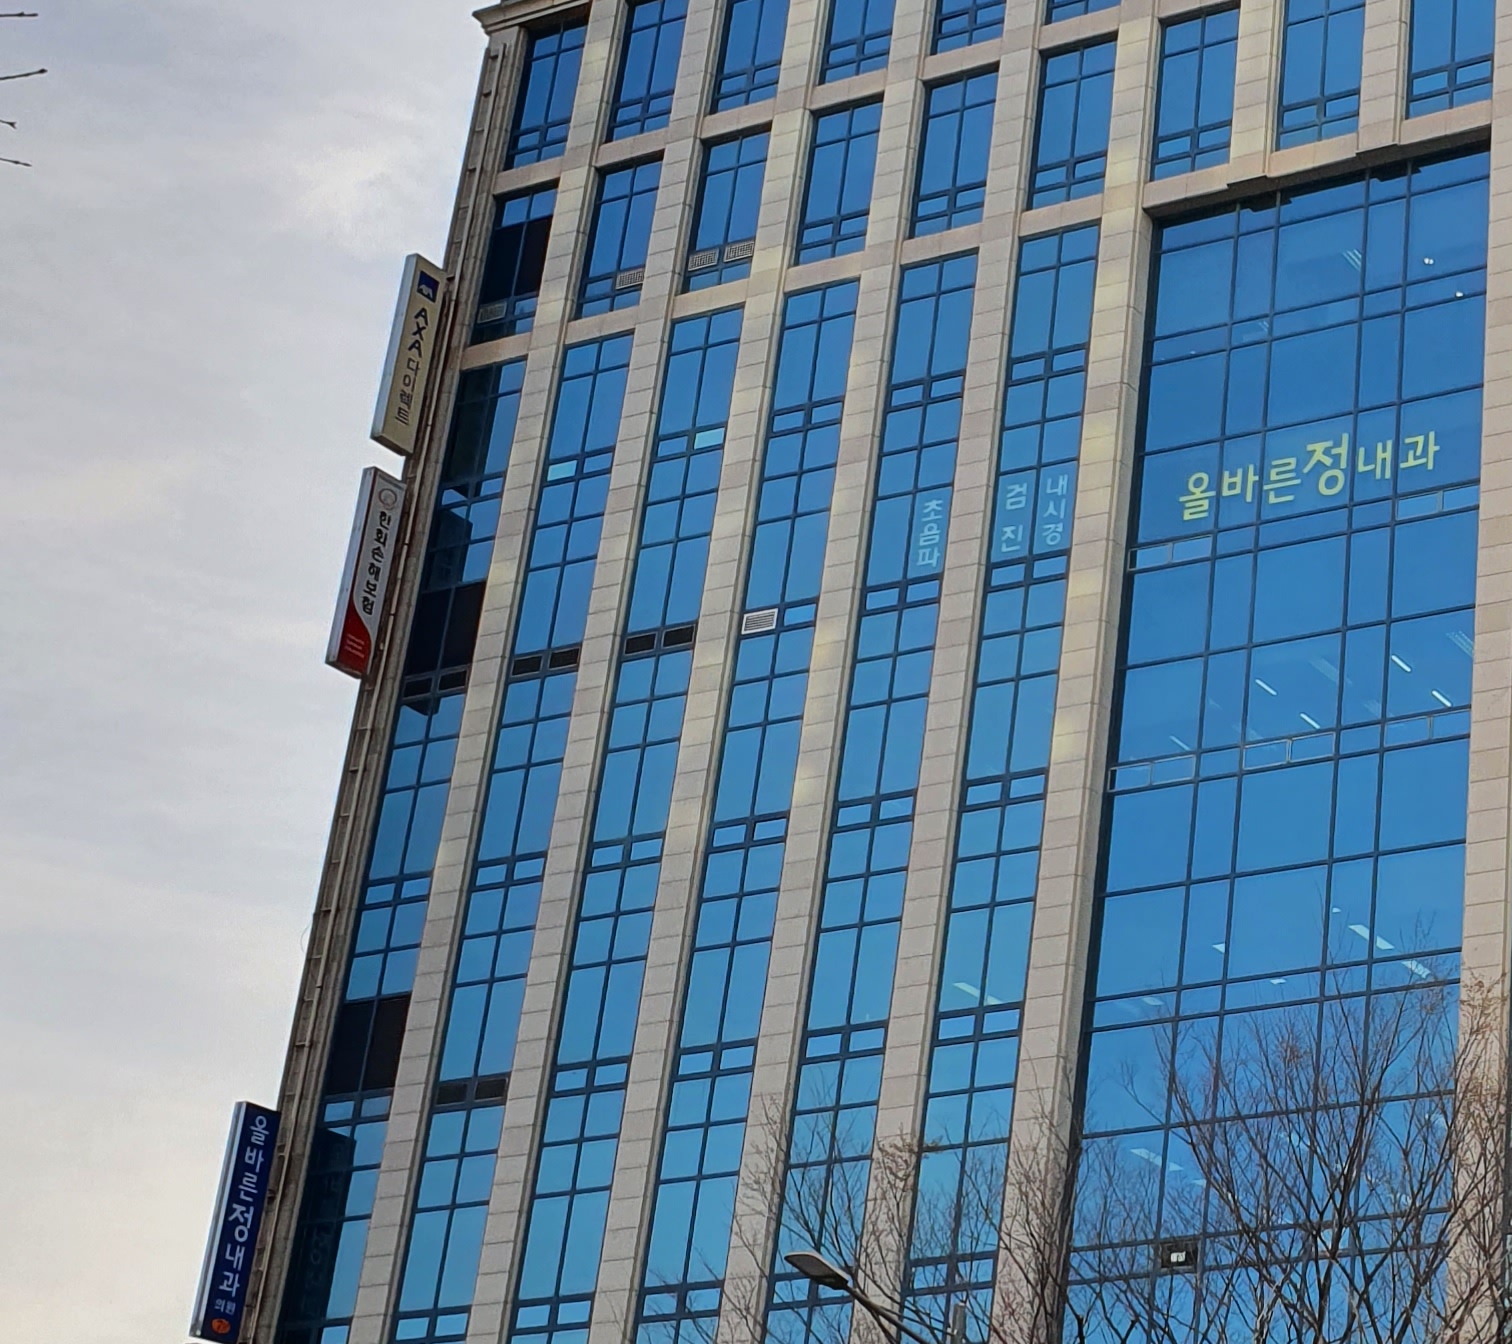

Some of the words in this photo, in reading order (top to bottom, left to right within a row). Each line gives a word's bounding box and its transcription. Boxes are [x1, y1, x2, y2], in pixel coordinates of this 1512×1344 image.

[1042, 474, 1069, 546] 내시경
[1178, 431, 1441, 521] 올바른정내과
[916, 499, 944, 568] 초음파
[1001, 482, 1028, 553] 검진
[361, 511, 392, 616] 한화손해보험
[218, 1114, 270, 1298] 올바른정내과
